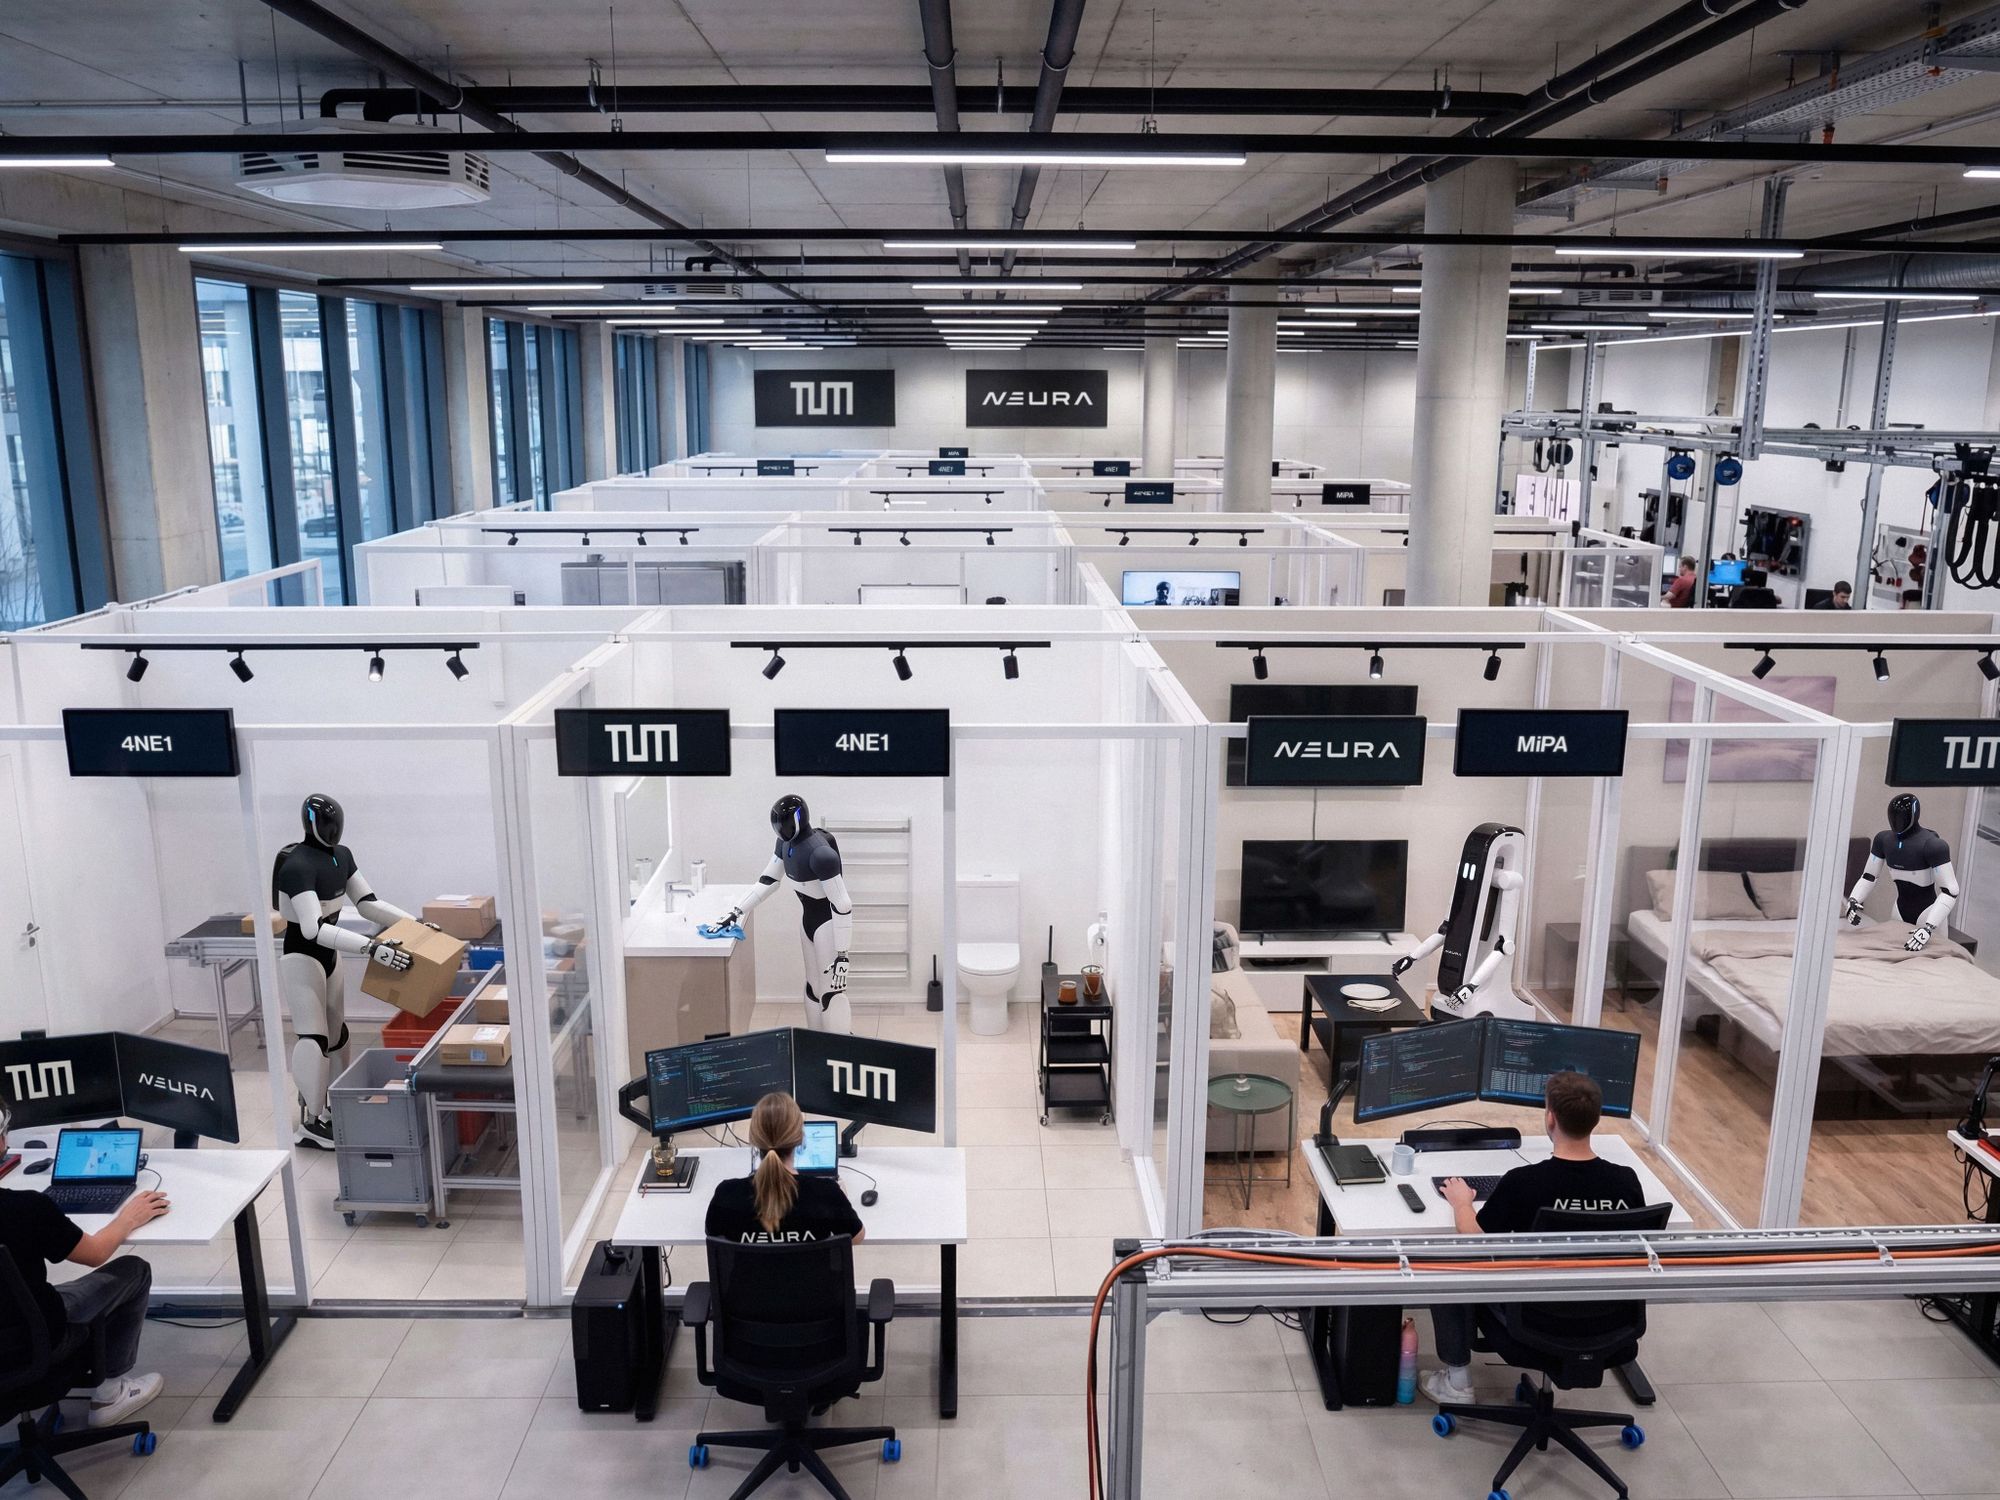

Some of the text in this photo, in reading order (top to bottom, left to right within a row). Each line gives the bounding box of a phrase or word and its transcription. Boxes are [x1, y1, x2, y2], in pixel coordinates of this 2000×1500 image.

[790, 381, 853, 415] TUM
[982, 391, 1093, 406] NEURA
[121, 735, 173, 752] 4NE1
[604, 724, 679, 762] TUM
[835, 734, 889, 752] 4NE1
[1273, 741, 1401, 759] NEURA
[1517, 735, 1568, 753] MiPA
[4, 1060, 76, 1102] TUM
[138, 1072, 215, 1101] NEURA
[826, 1059, 896, 1103] TUM
[1553, 1198, 1629, 1211] NEURA
[740, 1230, 816, 1244] NEURA
